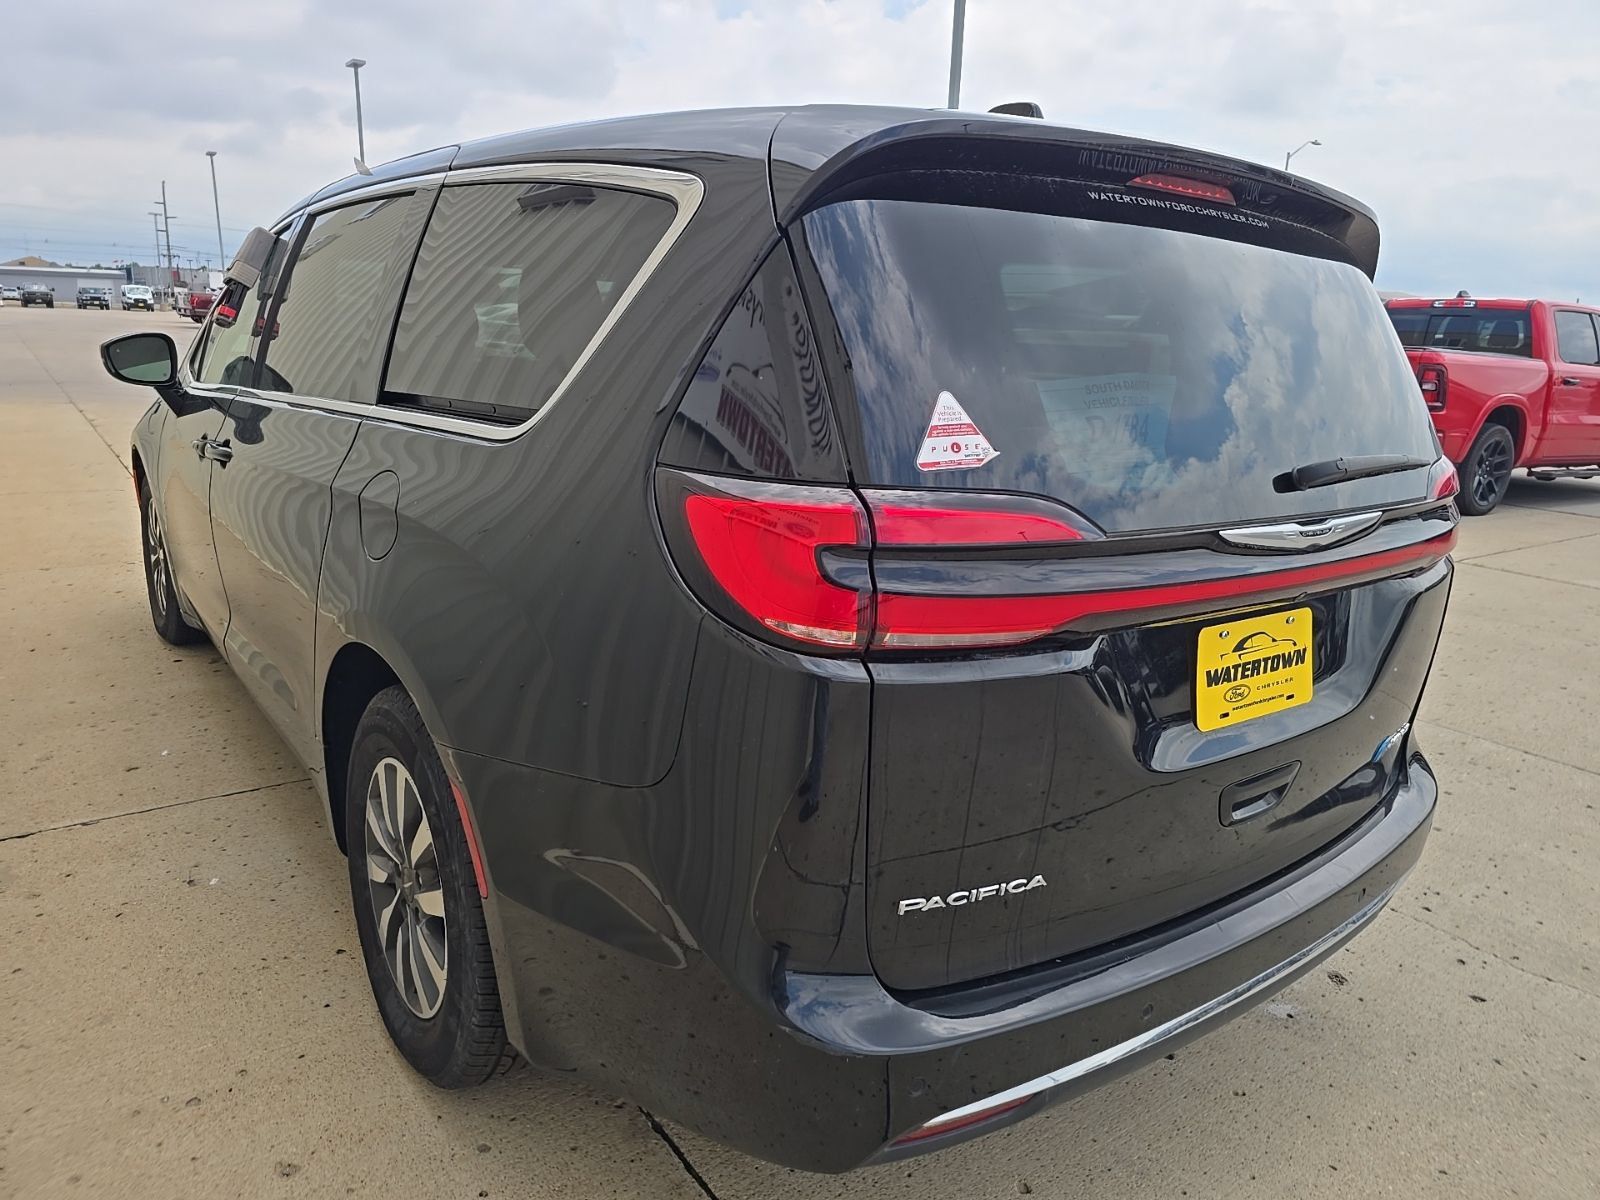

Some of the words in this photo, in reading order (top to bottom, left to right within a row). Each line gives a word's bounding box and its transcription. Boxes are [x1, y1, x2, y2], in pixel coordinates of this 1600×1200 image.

[1087, 191, 1269, 229] WATERTOWNFORDCHRYSLER.COM
[1205, 645, 1308, 688] WATERTOWN
[1256, 676, 1294, 691] CHRYSLER
[897, 874, 1047, 916] PACIFICA
